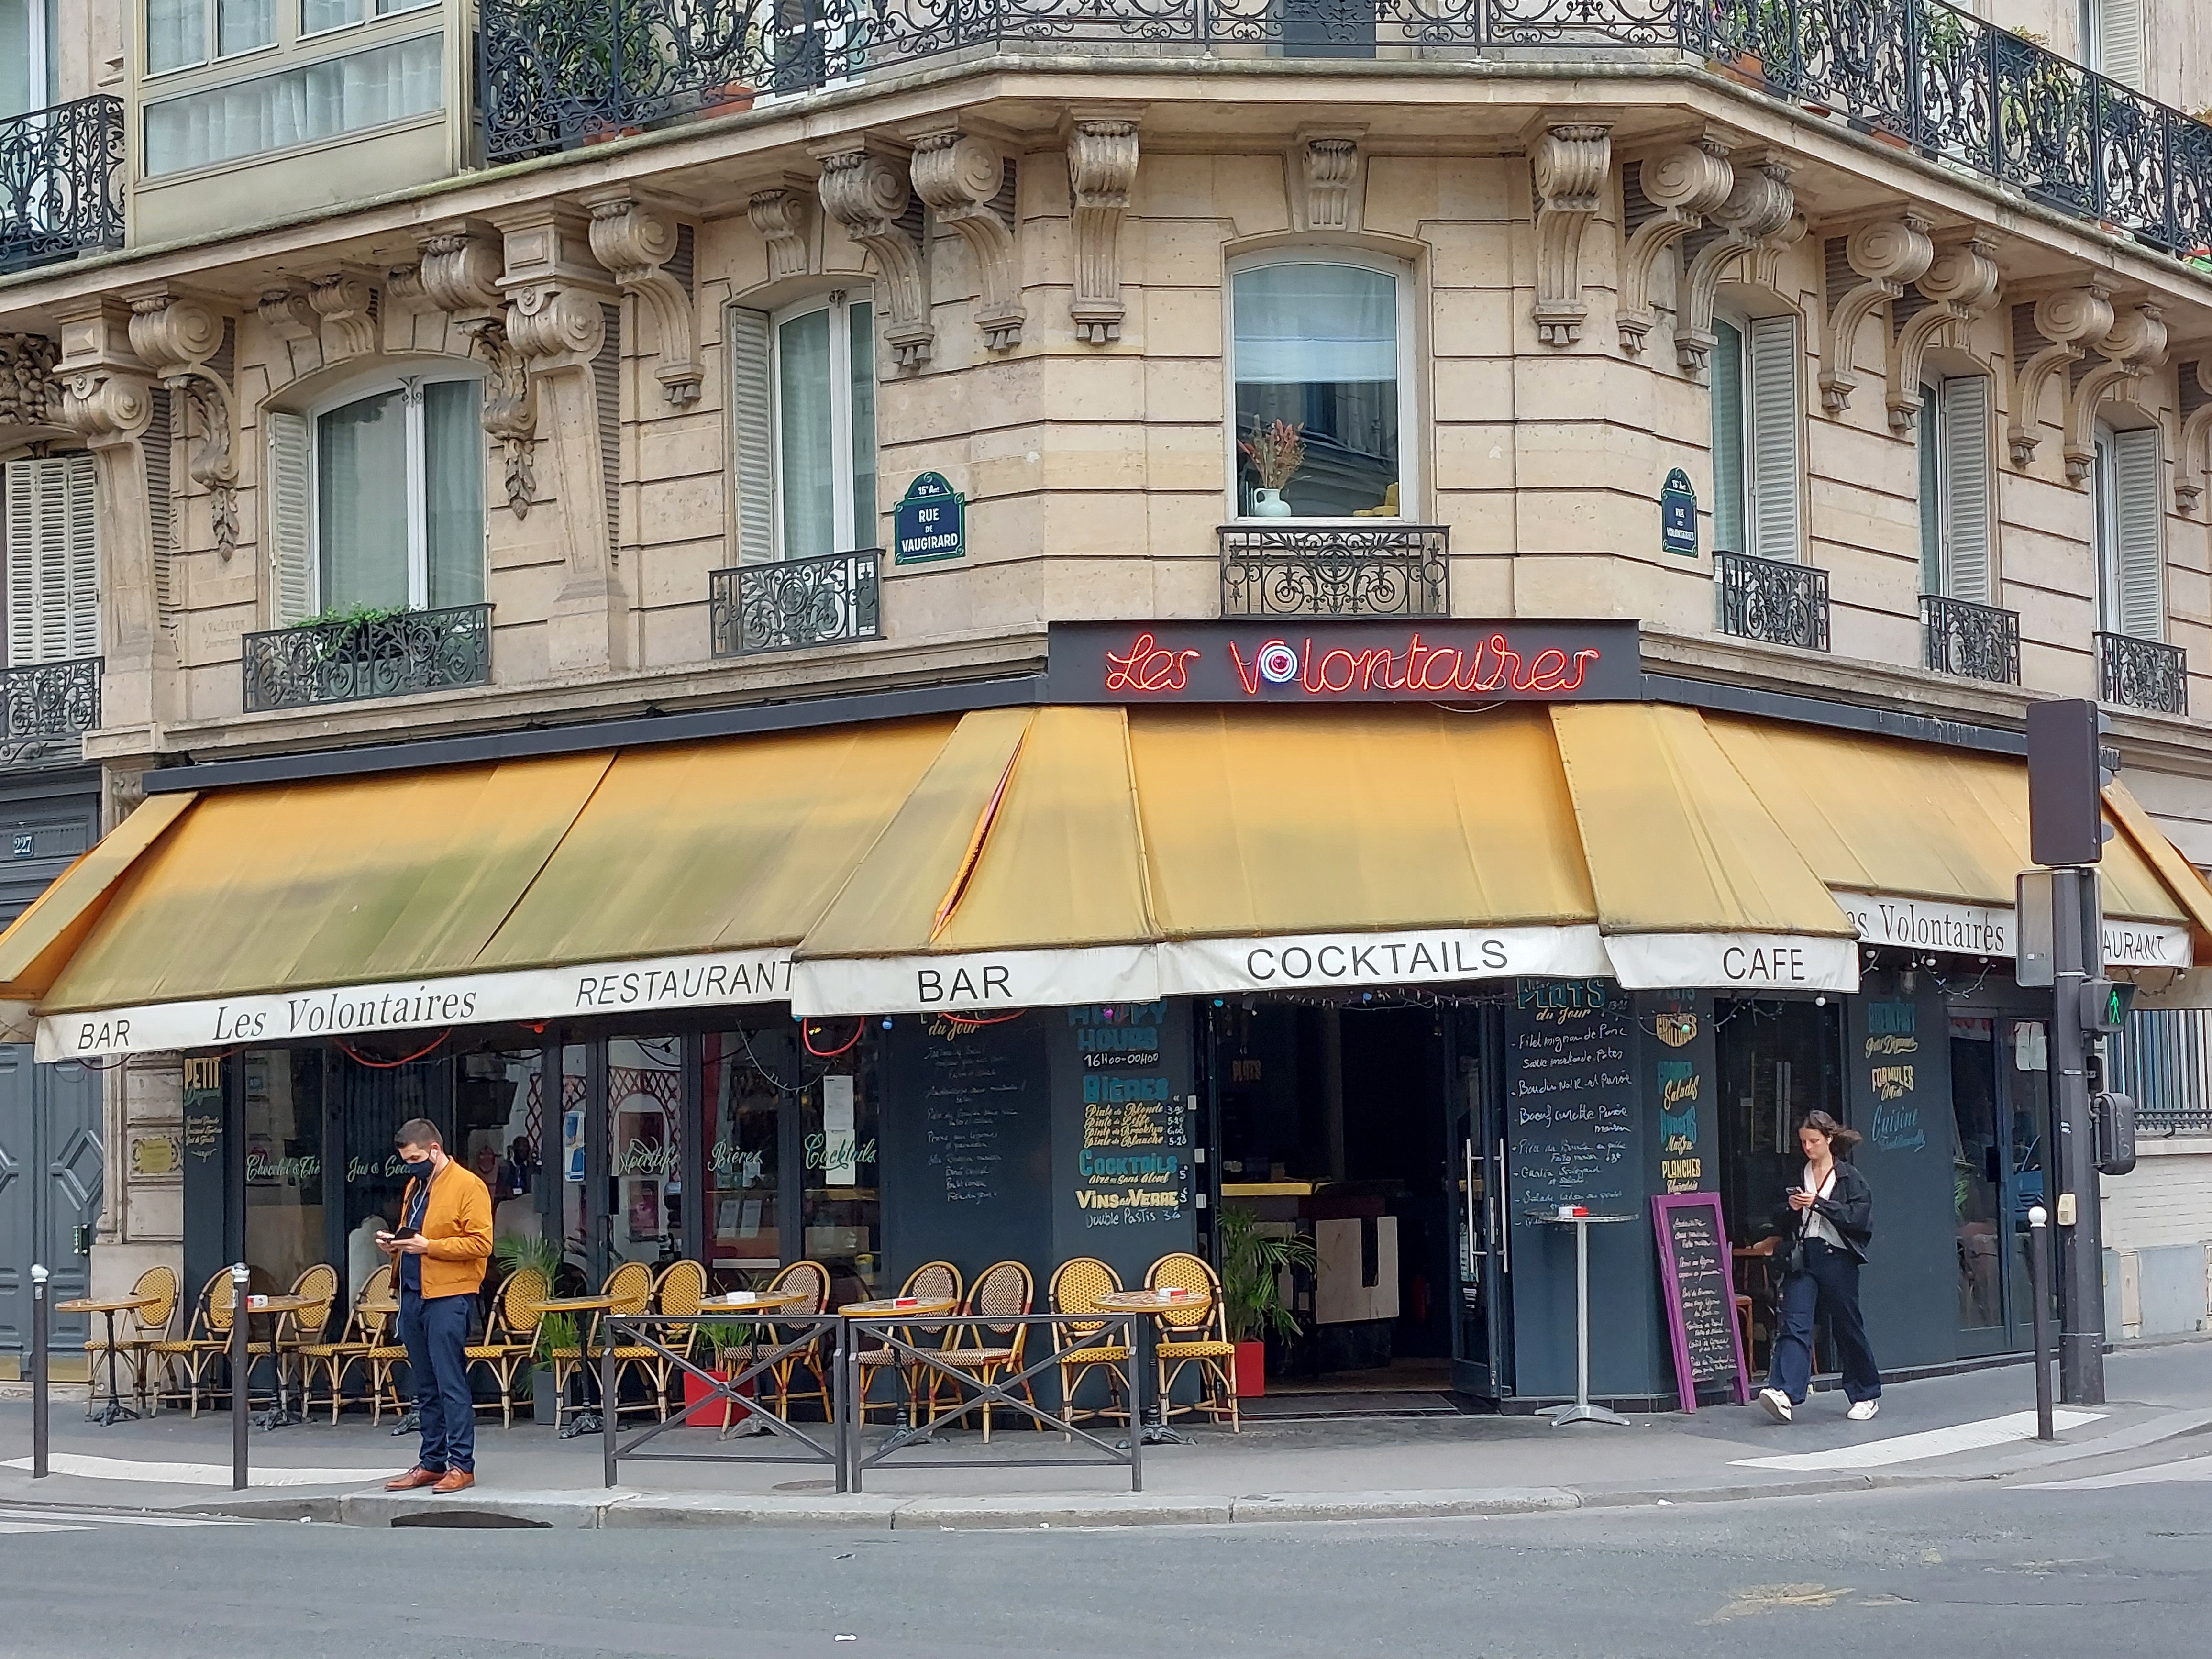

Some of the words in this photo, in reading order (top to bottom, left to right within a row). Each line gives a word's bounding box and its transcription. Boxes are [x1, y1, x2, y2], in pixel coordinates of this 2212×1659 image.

[918, 508, 940, 523] RUE
[925, 525, 934, 533] DE
[901, 533, 958, 553] VAUGIRARD
[1106, 633, 1200, 690] Les
[1229, 632, 1601, 695] Volontaires
[14, 836, 33, 854] 227
[1878, 904, 2004, 952] Volontaires
[2103, 929, 2167, 960] AURANT
[1247, 939, 1508, 980] COCKTAILS
[1722, 947, 1806, 982] CAFE
[917, 965, 1013, 1003] BAR
[77, 1019, 131, 1050] BAR
[212, 1006, 267, 1040] Les
[287, 985, 477, 1035] Volontaires
[575, 960, 793, 1008] RESTAURANT
[1536, 1008, 1554, 1021] du
[1557, 1006, 1592, 1025] Jour
[928, 1019, 947, 1036] du
[1077, 1027, 1158, 1051] HOURS
[1872, 1064, 1913, 1093] FORMULES
[1124, 1102, 1164, 1117] Blonde
[1872, 1104, 1918, 1142] Cuisine
[804, 1133, 878, 1171] Cocktails
[1120, 1134, 1164, 1148] Blanche
[346, 1156, 369, 1183] Jus
[1661, 1158, 1701, 1179] PLANCHES
